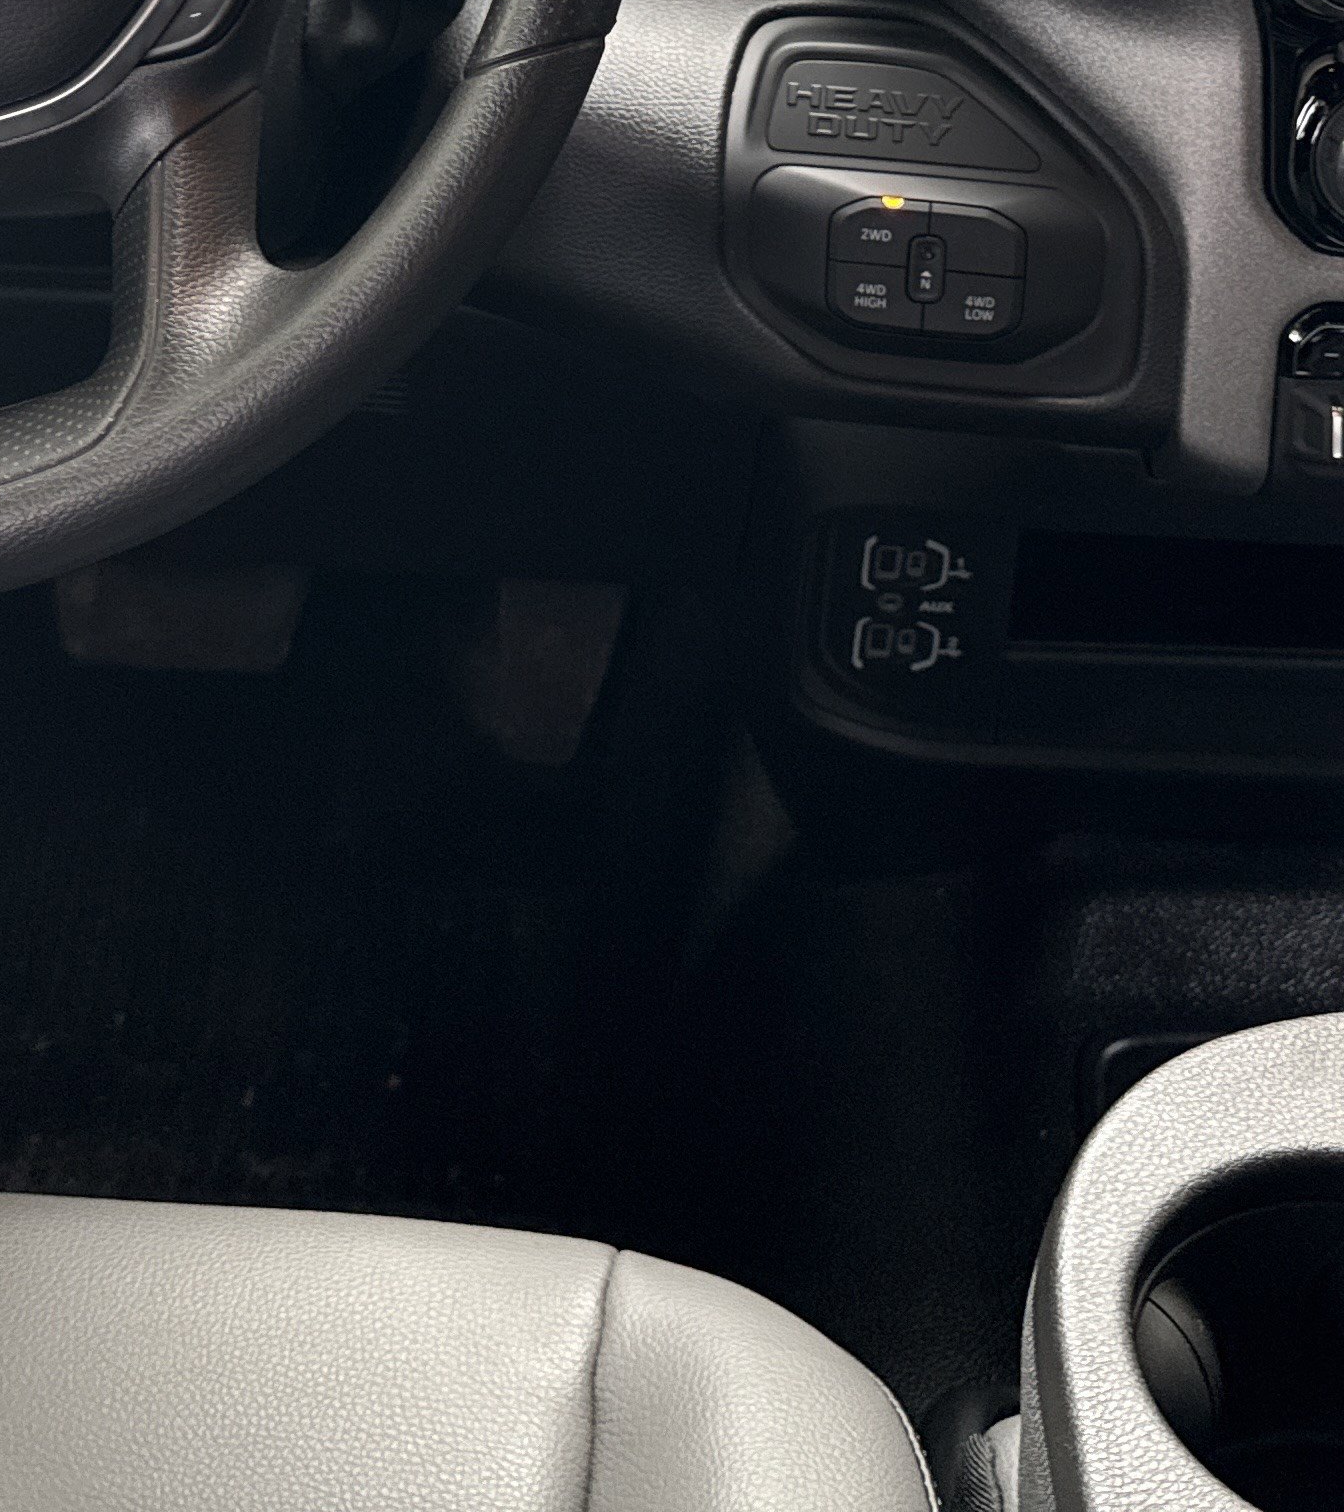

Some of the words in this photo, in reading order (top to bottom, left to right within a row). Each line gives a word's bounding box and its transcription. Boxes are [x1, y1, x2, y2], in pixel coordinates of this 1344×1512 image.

[786, 81, 965, 119] HEAVY
[806, 111, 953, 147] DUTY
[860, 227, 893, 243] 2WD
[856, 282, 887, 297] 4WD
[920, 278, 932, 290] N
[854, 295, 888, 310] HIGH
[964, 295, 996, 309] 4WD
[964, 308, 995, 323] LOW
